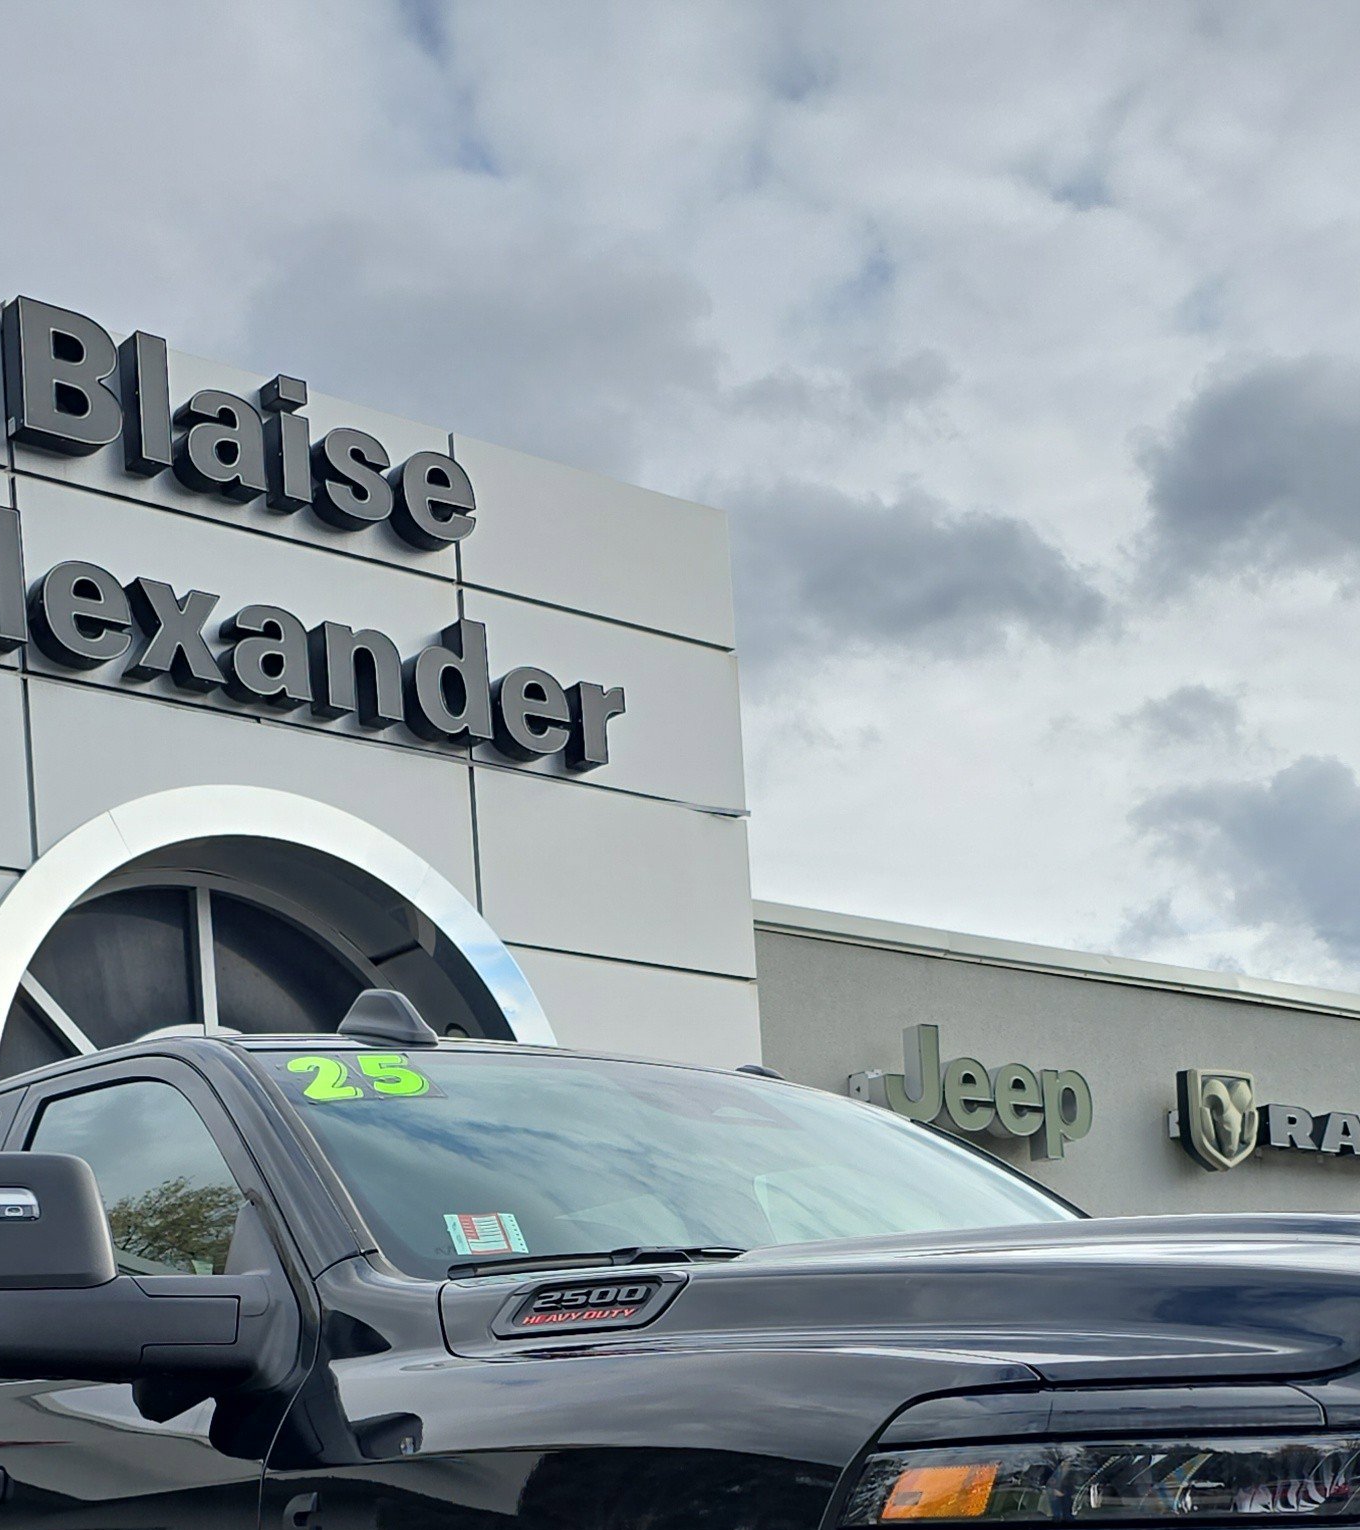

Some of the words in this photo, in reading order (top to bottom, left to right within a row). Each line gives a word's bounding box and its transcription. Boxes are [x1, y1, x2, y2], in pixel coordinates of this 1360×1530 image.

[2, 295, 477, 552] Blaise
[286, 1053, 430, 1101] 25
[868, 1023, 1093, 1161] Jeep
[522, 1311, 582, 1325] HEAVY
[582, 1307, 636, 1321] DUTY
[533, 1285, 650, 1312] 2500
